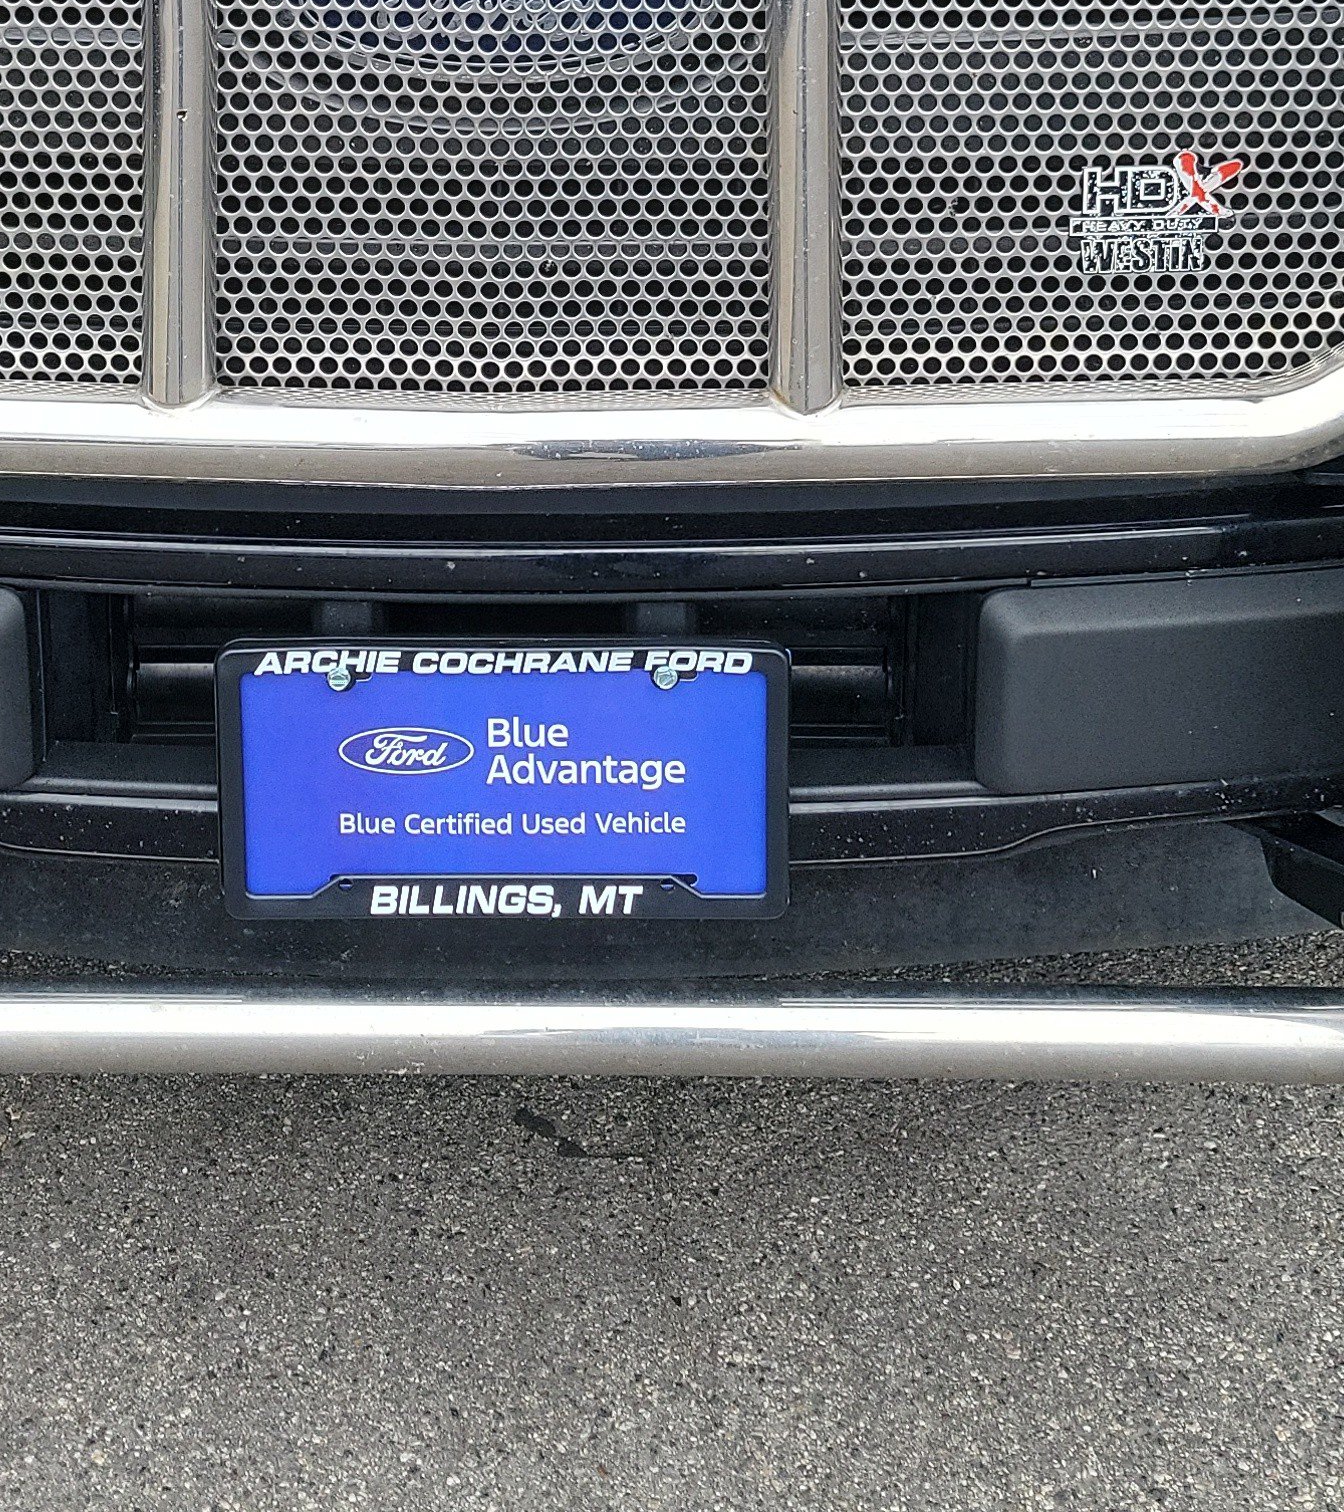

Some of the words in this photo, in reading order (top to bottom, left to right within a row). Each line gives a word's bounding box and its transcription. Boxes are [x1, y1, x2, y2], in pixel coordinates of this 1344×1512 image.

[1082, 149, 1244, 219] HDX
[1081, 220, 1143, 232] HEAVY
[253, 650, 402, 676] ARCHIE
[412, 651, 634, 675] COCHRANE
[644, 651, 754, 675] FORD
[487, 717, 569, 749] Blue
[364, 733, 449, 768] Ford
[485, 753, 686, 790] Advantage
[339, 813, 396, 835] Blue
[404, 812, 513, 835] Certified
[521, 813, 587, 835] Used
[594, 812, 686, 834] Vehicle
[370, 885, 562, 918] BILLINGS,
[578, 886, 644, 914] MT
